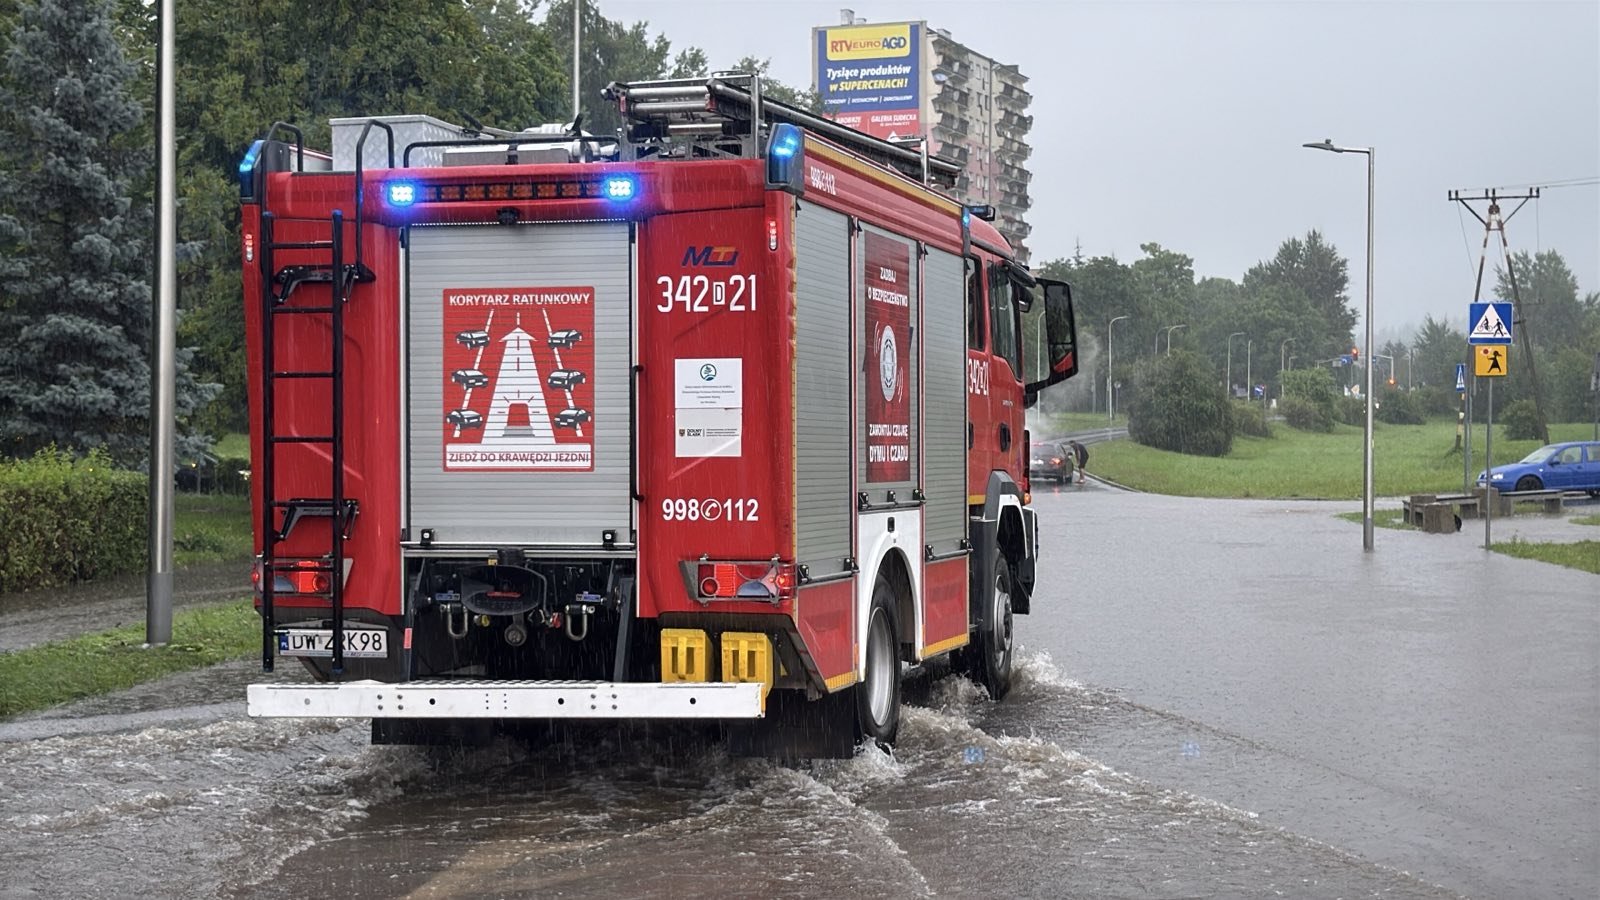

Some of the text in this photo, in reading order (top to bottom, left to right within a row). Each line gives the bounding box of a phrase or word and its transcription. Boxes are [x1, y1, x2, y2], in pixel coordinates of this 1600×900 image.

[831, 40, 852, 52] RTV
[882, 37, 907, 49] AGD
[826, 64, 911, 80] Tysiące produktów
[839, 78, 908, 91] SUPERCENACH!
[450, 293, 590, 306] KORYTARZ RATUNKOWY
[480, 453, 496, 462] DO
[498, 453, 552, 464] KRAWĘDZI
[554, 453, 589, 462] JEZDNI
[662, 498, 759, 521] 998 112
